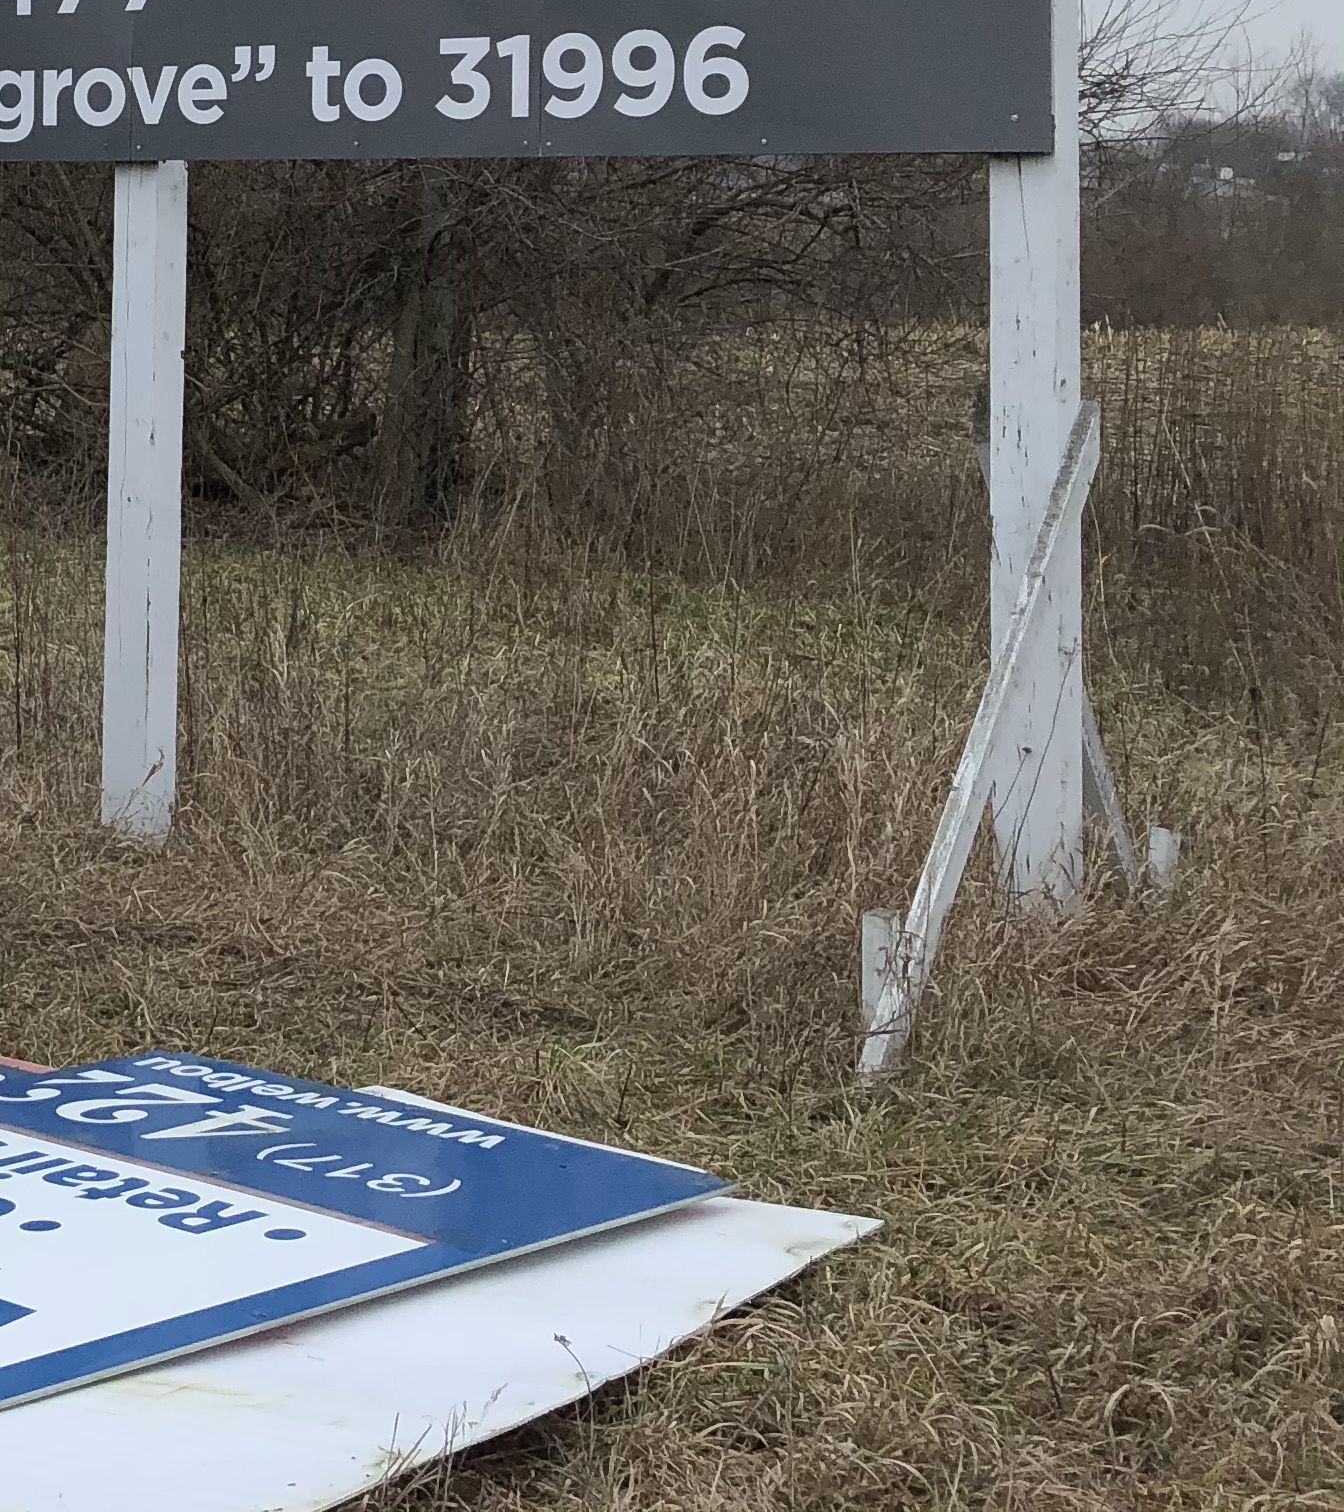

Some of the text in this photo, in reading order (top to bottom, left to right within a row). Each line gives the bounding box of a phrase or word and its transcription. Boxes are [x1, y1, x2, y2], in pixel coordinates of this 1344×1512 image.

[306, 46, 403, 123] to
[435, 25, 750, 121] 31996
[256, 1142, 462, 1198] (317)
